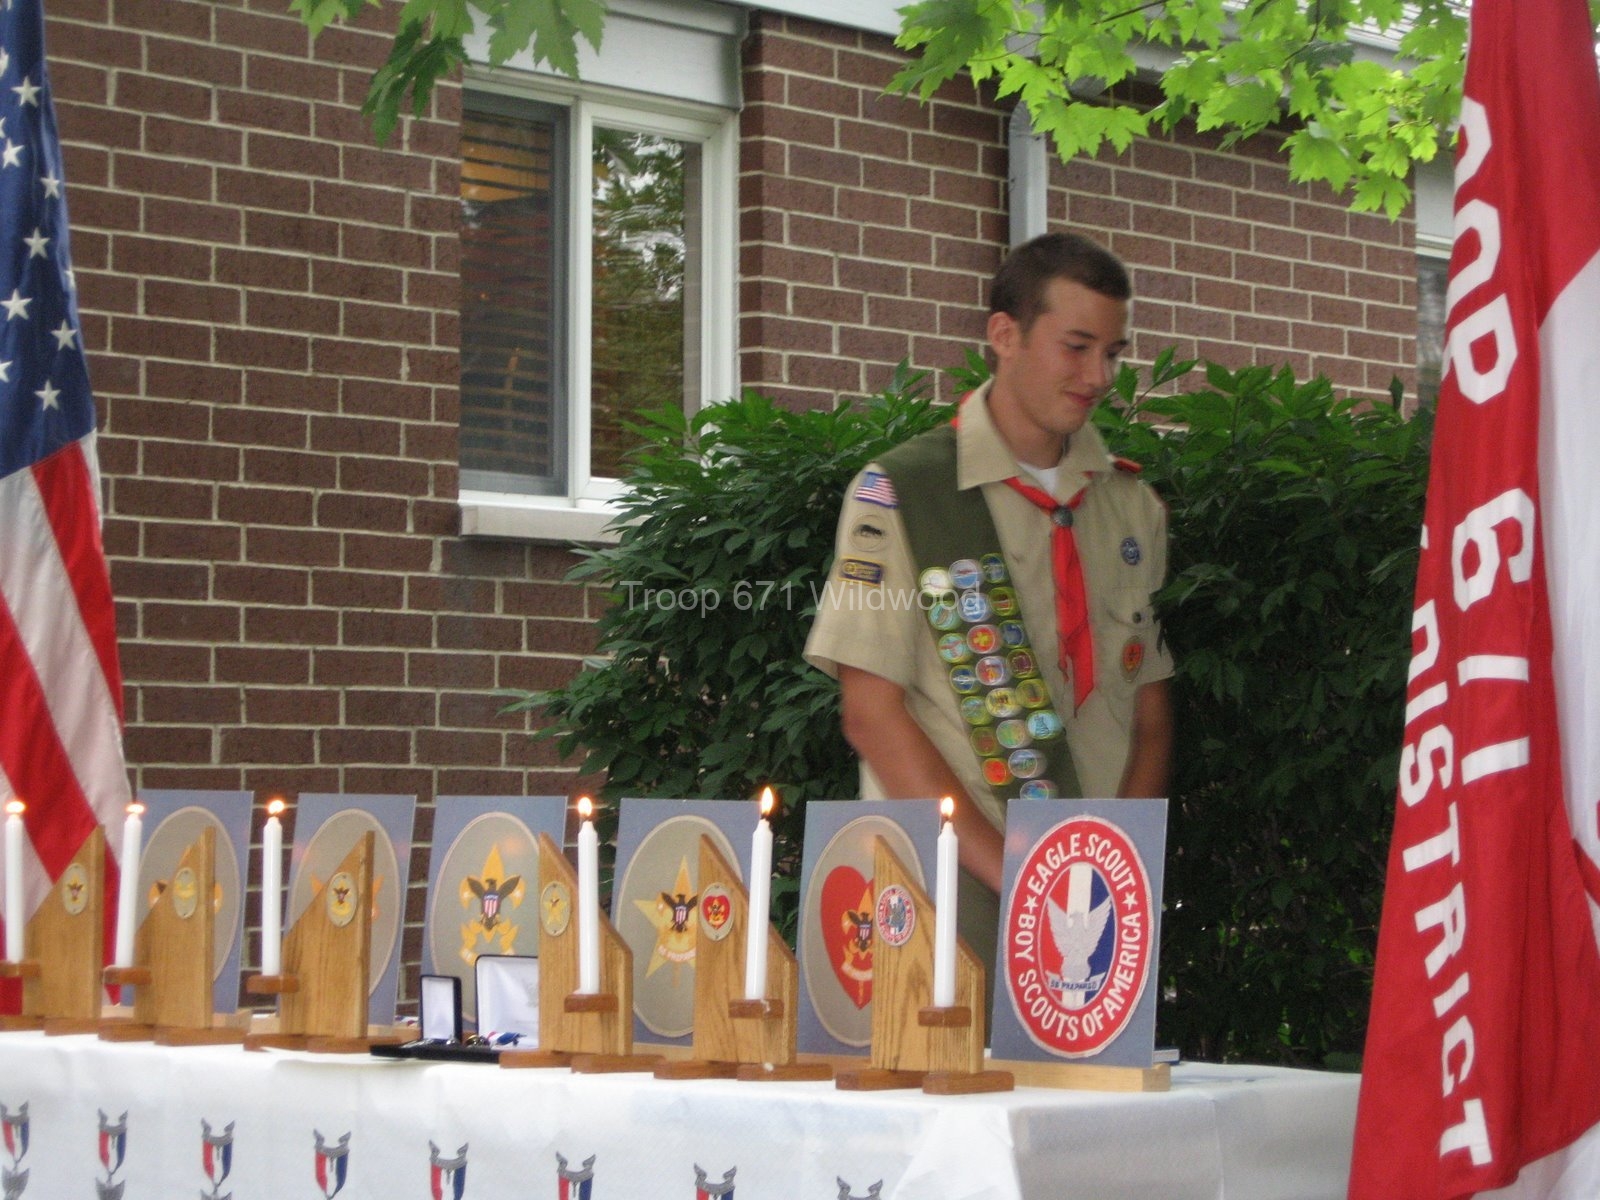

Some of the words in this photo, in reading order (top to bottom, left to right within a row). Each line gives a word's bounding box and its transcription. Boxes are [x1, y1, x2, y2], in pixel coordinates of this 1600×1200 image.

[1027, 832, 1081, 897] EAGLE
[1085, 833, 1137, 892] SCOUT
[1014, 913, 1037, 963] BOY
[1106, 911, 1143, 1022] AMERICA
[1018, 968, 1079, 1042] SCOUTS
[1080, 1007, 1107, 1039] OF
